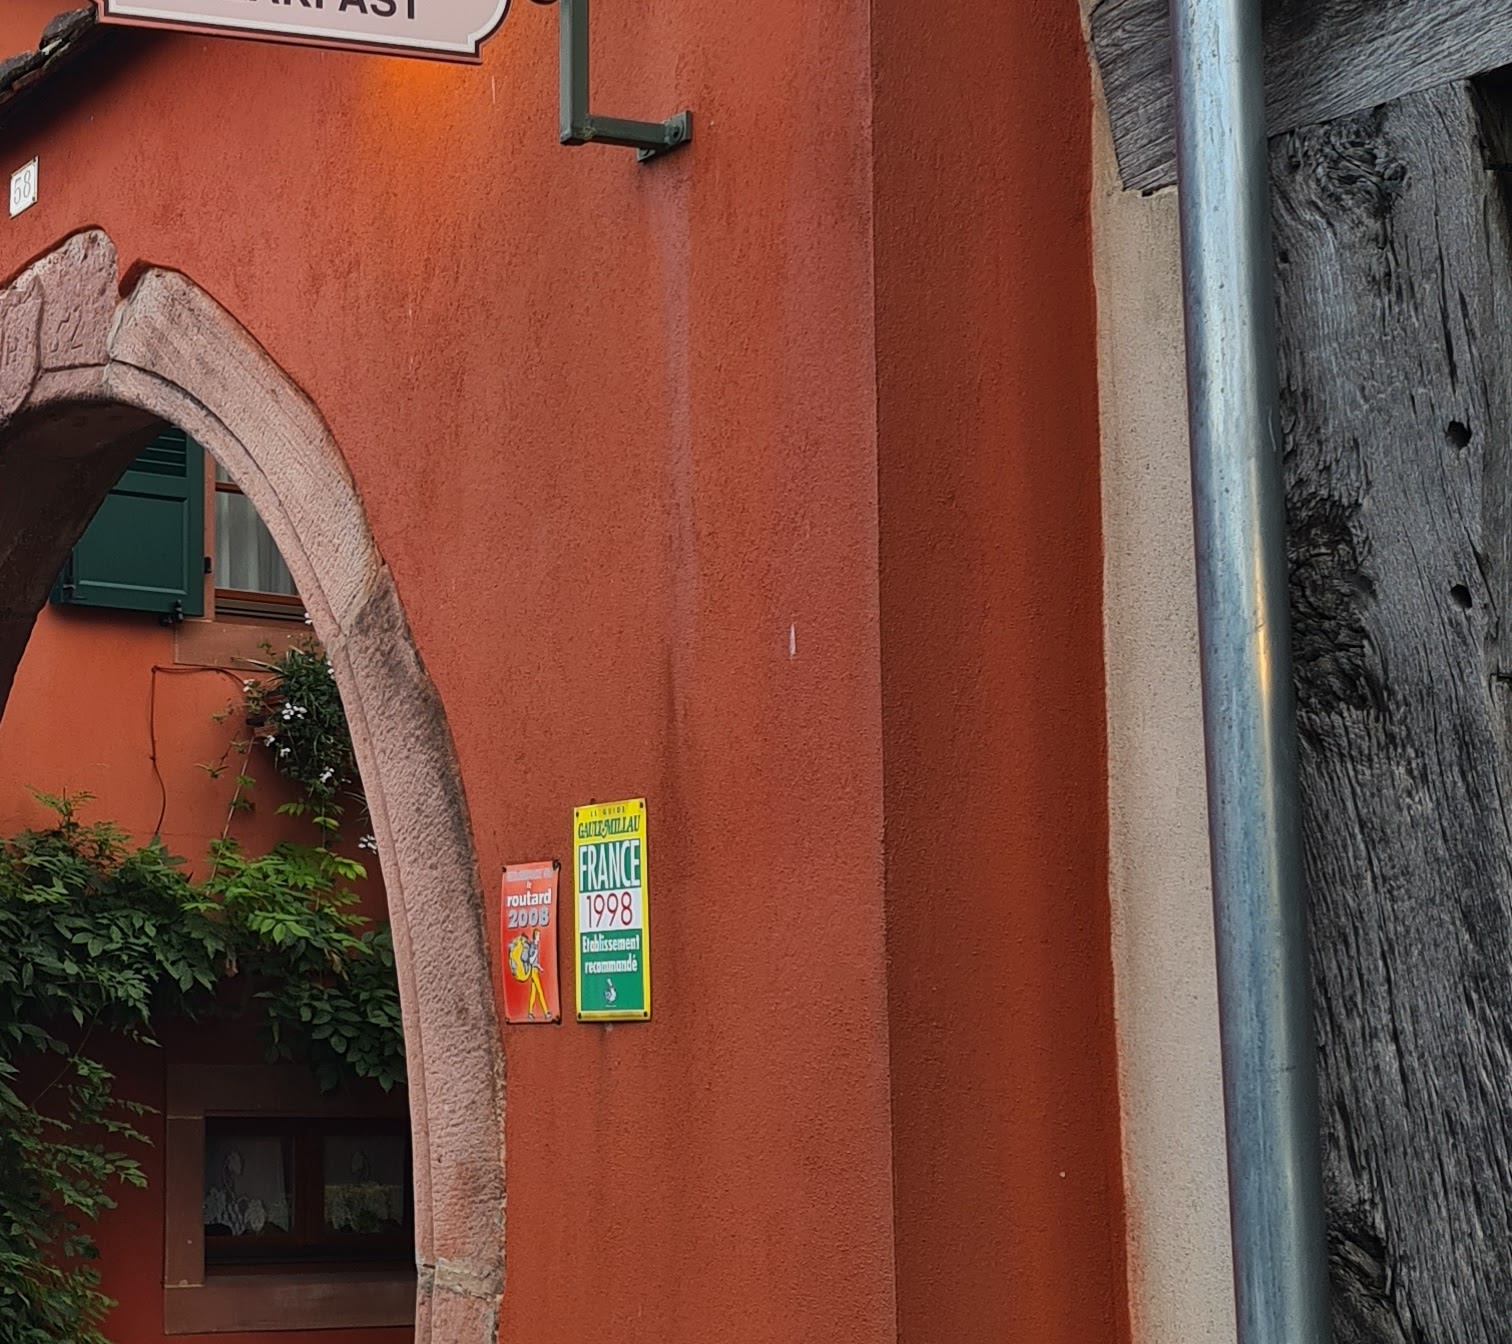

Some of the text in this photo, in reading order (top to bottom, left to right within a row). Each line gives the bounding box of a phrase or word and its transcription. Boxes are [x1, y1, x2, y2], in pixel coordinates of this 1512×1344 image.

[13, 169, 32, 205] 58
[579, 839, 641, 892] FRANCE
[506, 887, 552, 907] routard
[586, 891, 633, 928] 1998
[508, 905, 550, 929] 2008
[582, 933, 640, 953] Etablissement
